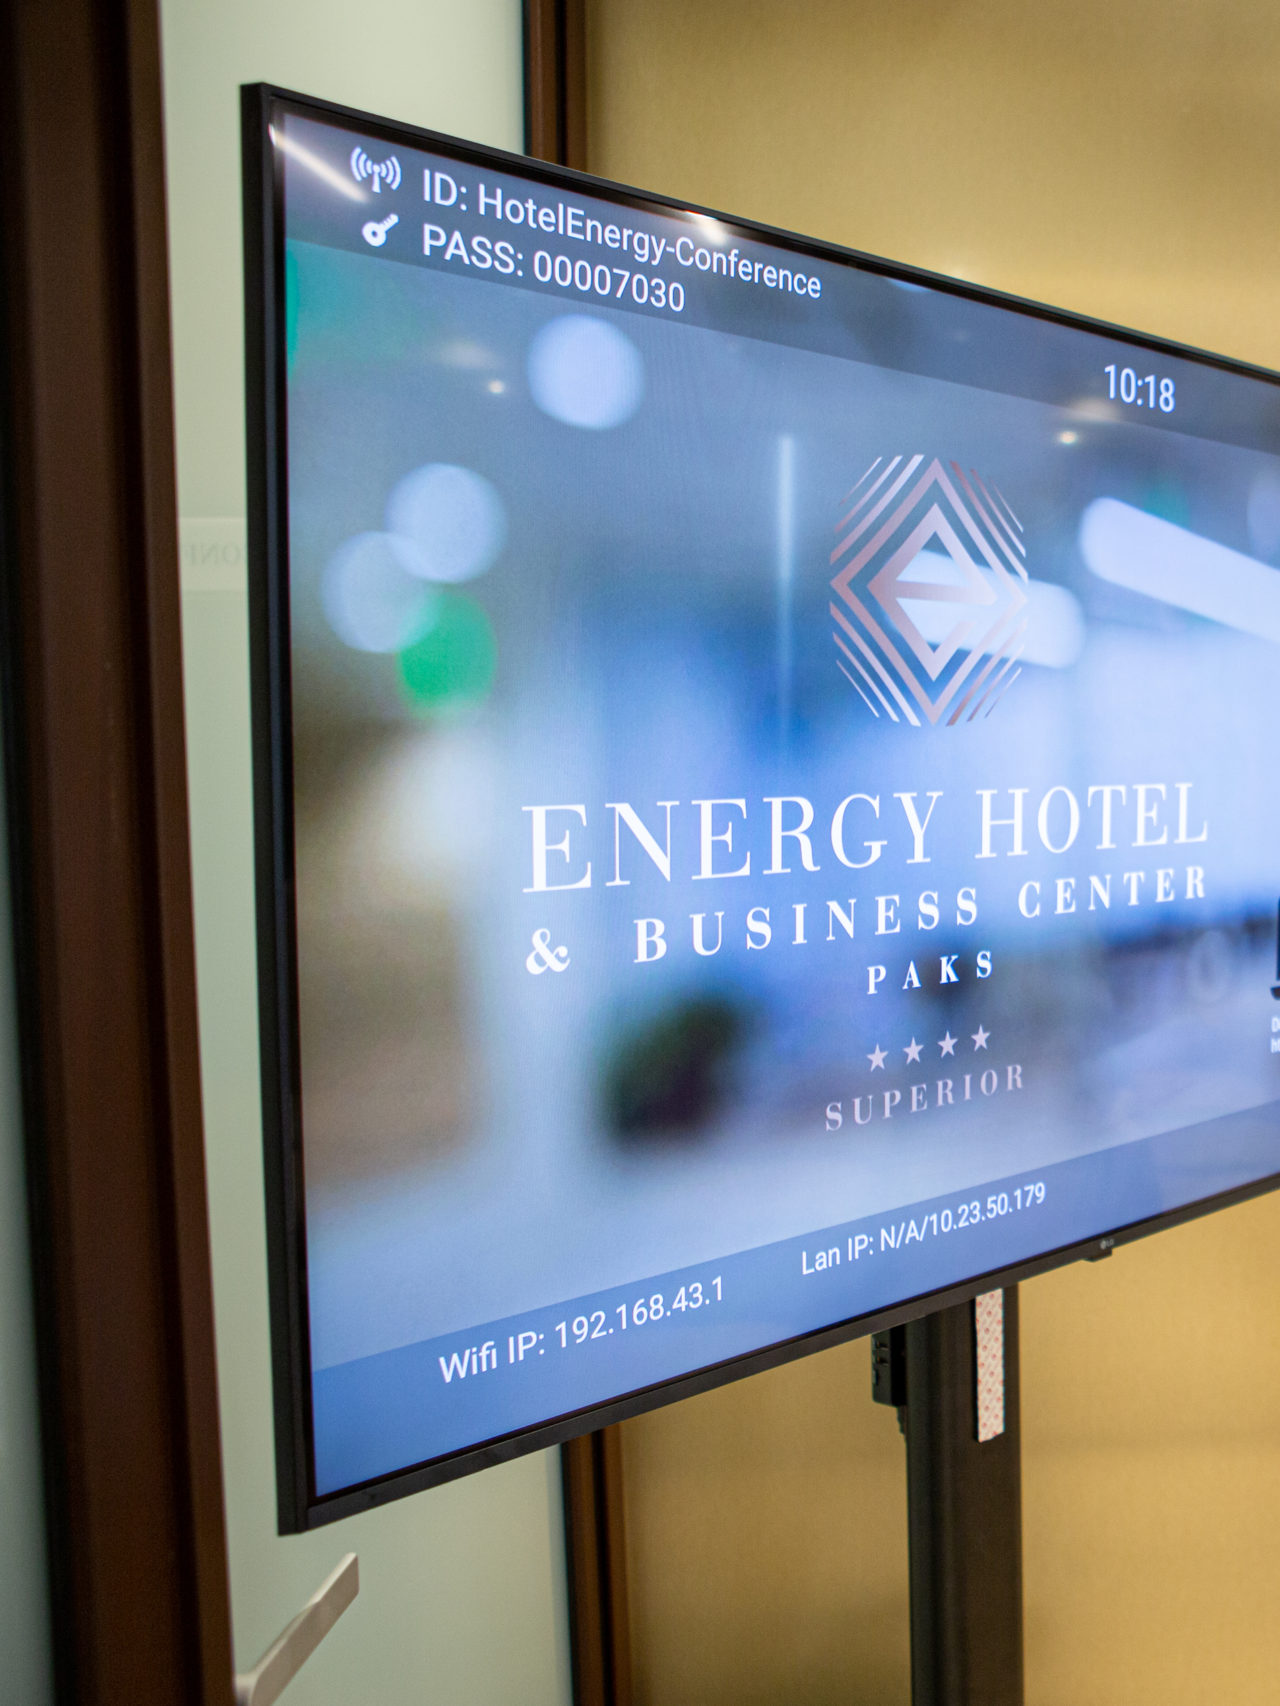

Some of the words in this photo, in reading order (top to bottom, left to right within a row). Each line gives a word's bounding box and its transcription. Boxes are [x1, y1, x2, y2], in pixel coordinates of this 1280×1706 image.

[422, 168, 468, 212] ID:
[479, 183, 822, 300] HotelEnergy-Conference
[422, 223, 524, 277] PASS:
[532, 250, 686, 313] 00007030
[1103, 363, 1176, 414] 10:18
[521, 790, 944, 894] ENERGY
[974, 782, 1209, 860] HOTEL
[525, 926, 572, 976] &
[633, 886, 979, 964] BUSINESS
[1017, 865, 1207, 919] CENTER
[866, 949, 994, 995] PAKS
[824, 1062, 1025, 1133] SUPERIOR
[801, 1250, 841, 1276] Lan
[847, 1233, 875, 1262] IP:
[880, 1181, 1047, 1252] N/A/10.23.50.179
[438, 1340, 497, 1384] Wifi
[508, 1330, 546, 1364] IP:
[555, 1275, 723, 1349] 192.168.43.1
